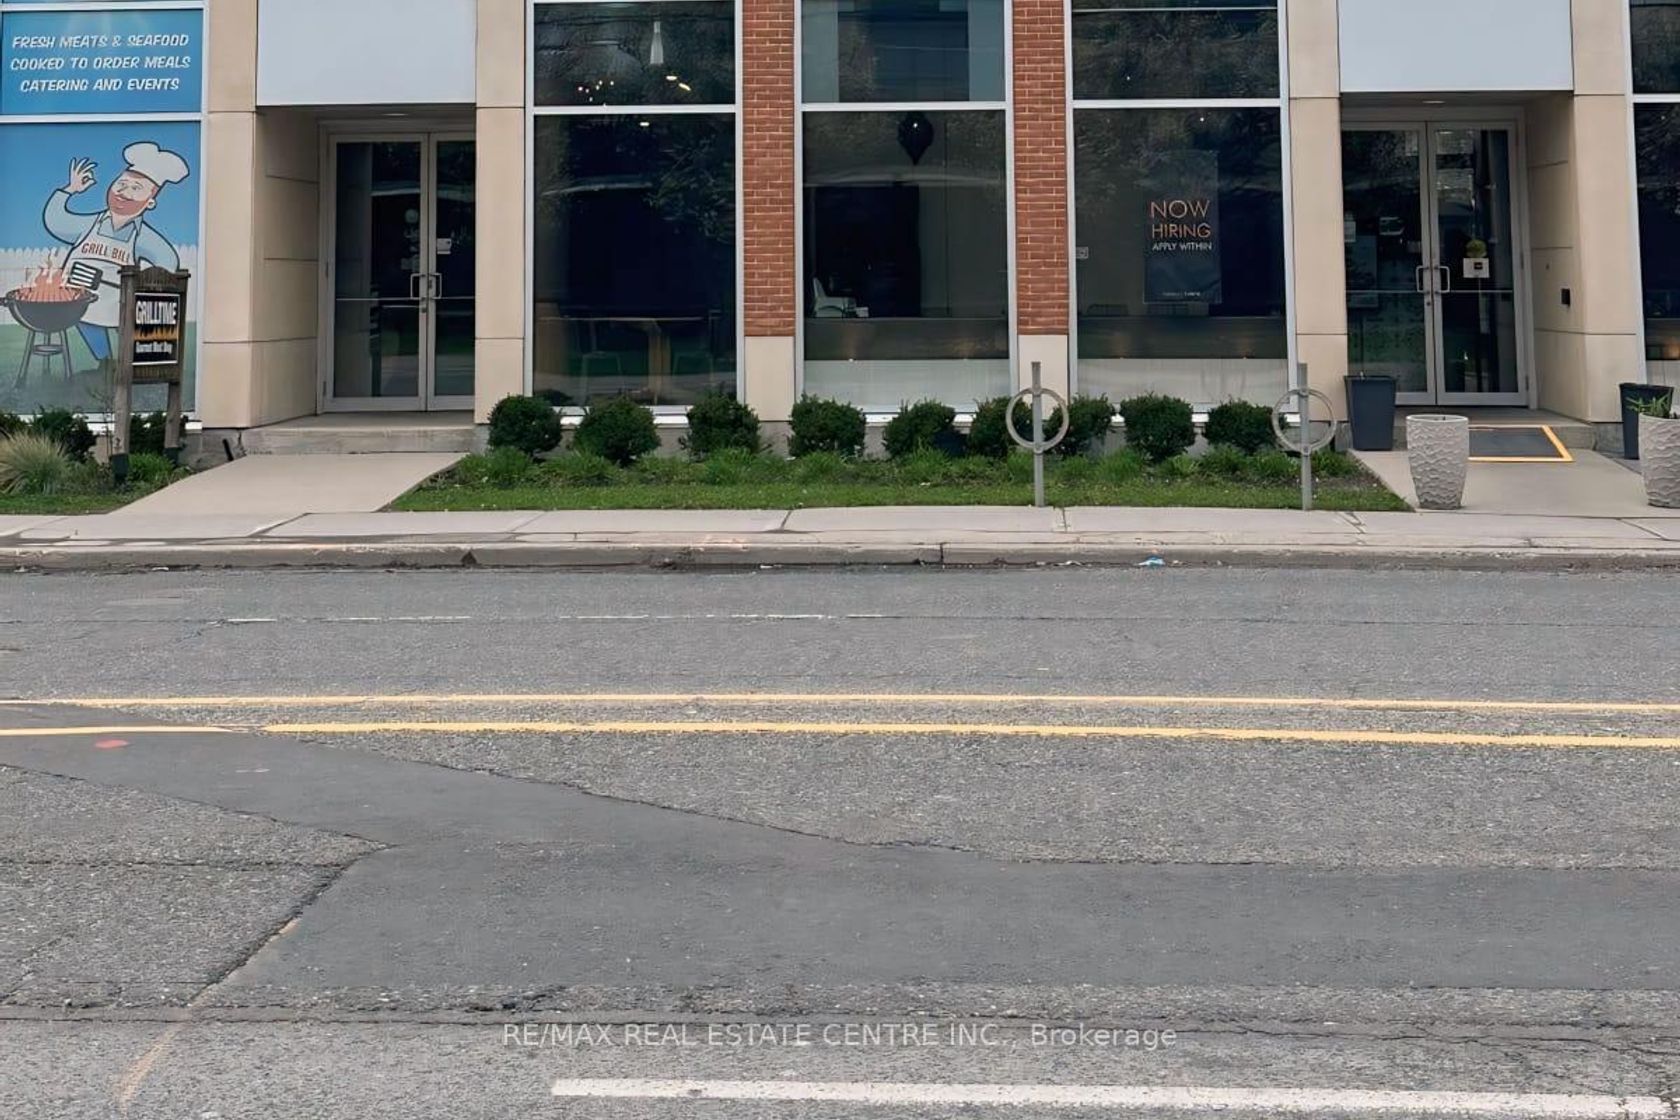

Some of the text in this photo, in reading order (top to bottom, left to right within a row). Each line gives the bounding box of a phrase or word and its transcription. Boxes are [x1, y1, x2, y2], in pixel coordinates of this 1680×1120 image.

[12, 34, 189, 49] FRESH MEATS & SEAFOOD
[11, 55, 191, 71] COOKED TO ORDER MEALS
[20, 78, 180, 92] CATERING AND EVENTS
[1150, 200, 1210, 219] NOW
[1152, 223, 1211, 239] HIRING
[1152, 242, 1212, 251] APPLY WITHIN
[136, 301, 177, 325] GRILLTIME
